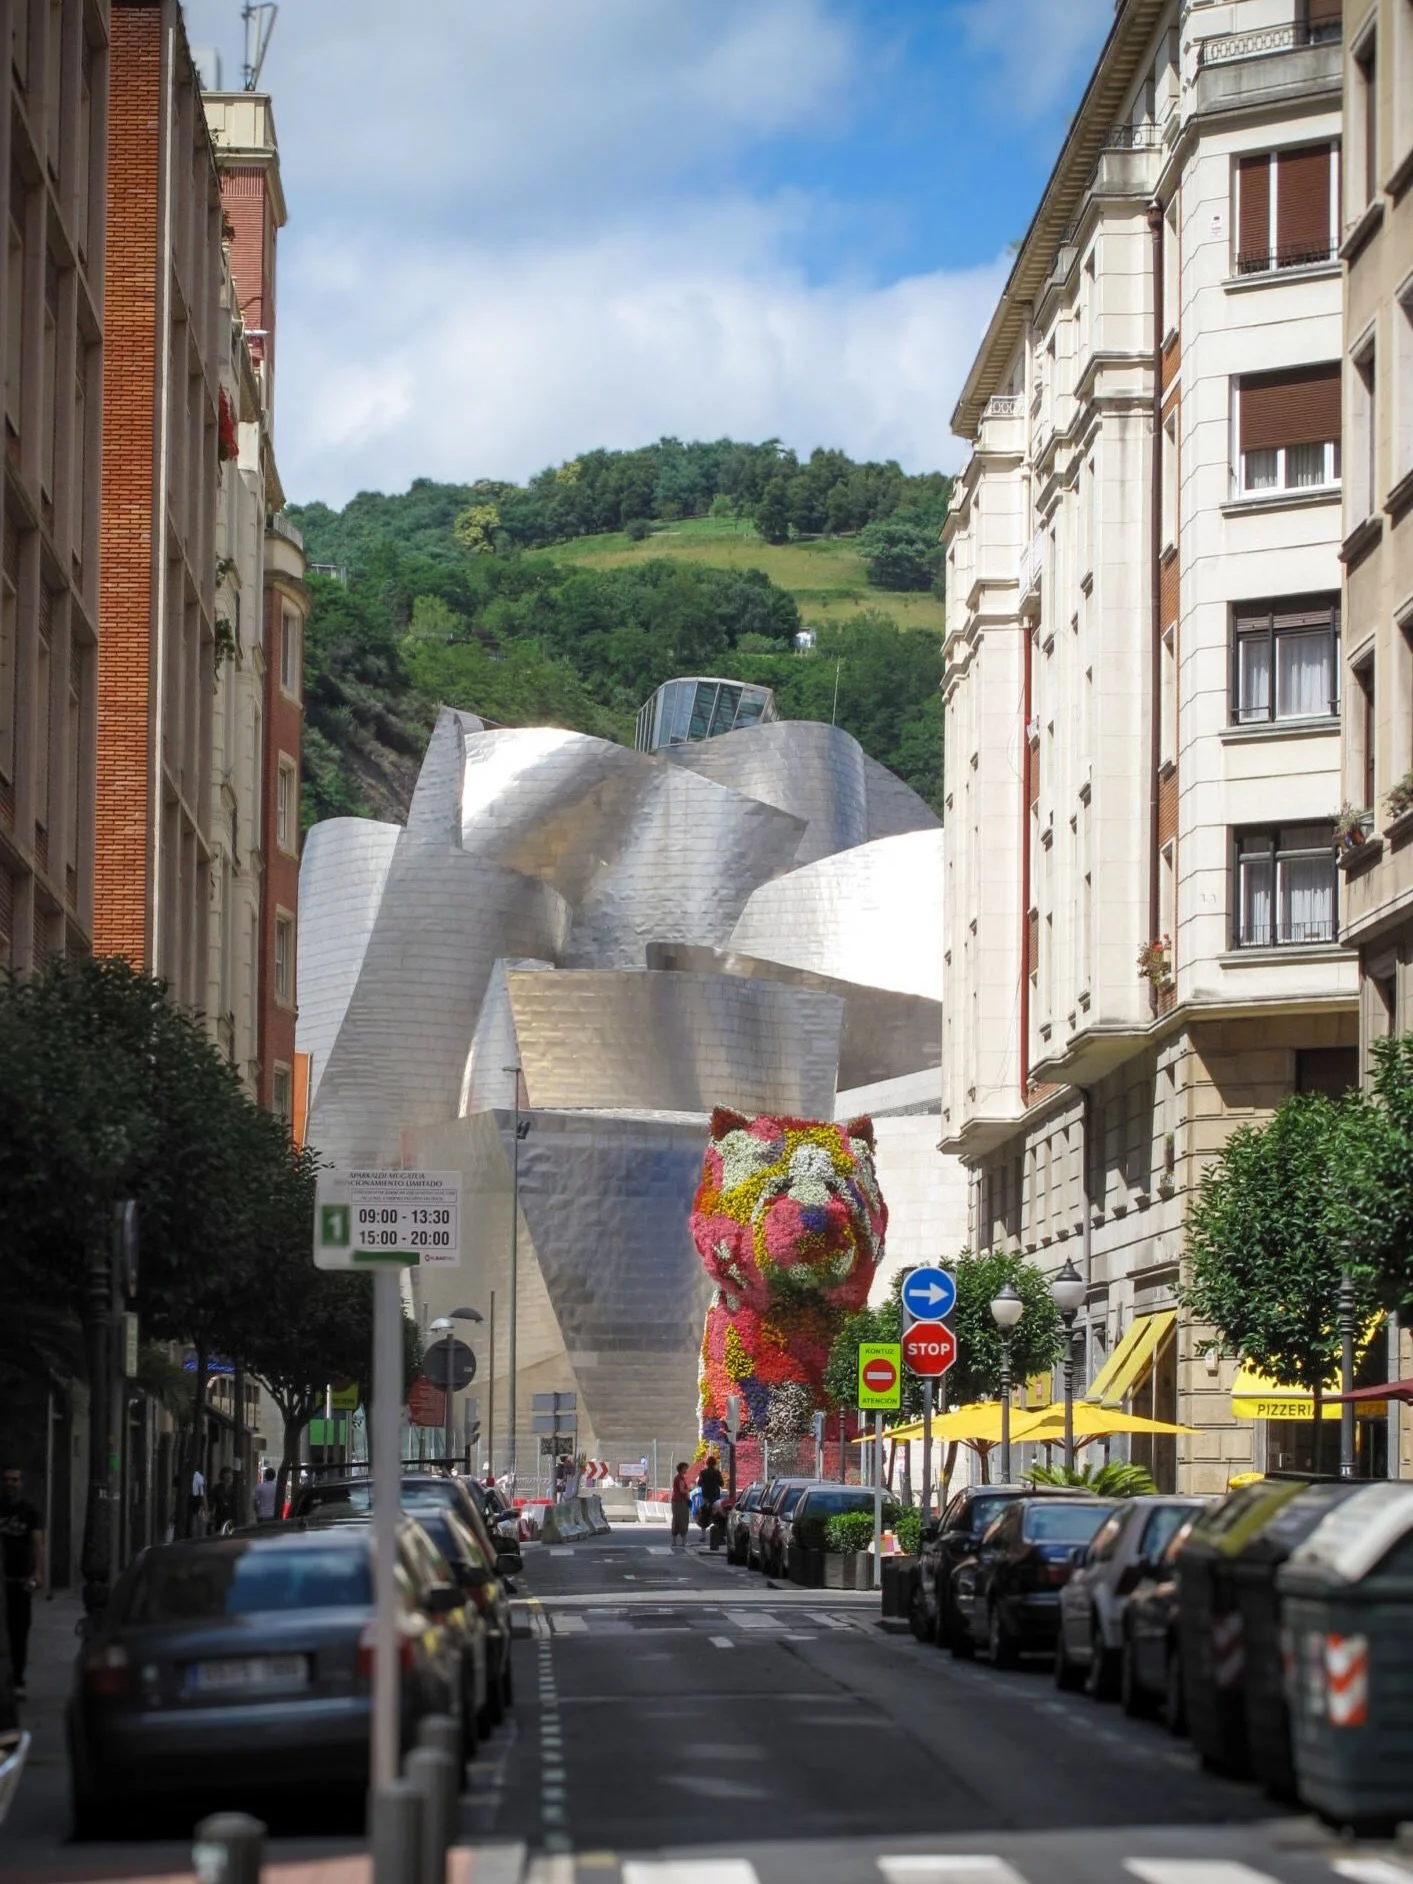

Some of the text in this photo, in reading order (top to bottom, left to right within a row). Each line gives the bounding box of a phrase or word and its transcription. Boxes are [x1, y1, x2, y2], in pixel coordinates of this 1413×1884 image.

[406, 1179, 442, 1187] LIMITADO
[359, 1208, 398, 1224] 09:00
[412, 1209, 450, 1225] 13:30
[328, 1214, 343, 1240] 1
[359, 1231, 398, 1246] 15:00
[410, 1231, 450, 1247] 20:00
[907, 1343, 950, 1356] STOP
[1257, 1404, 1315, 1417] PIZZERI
